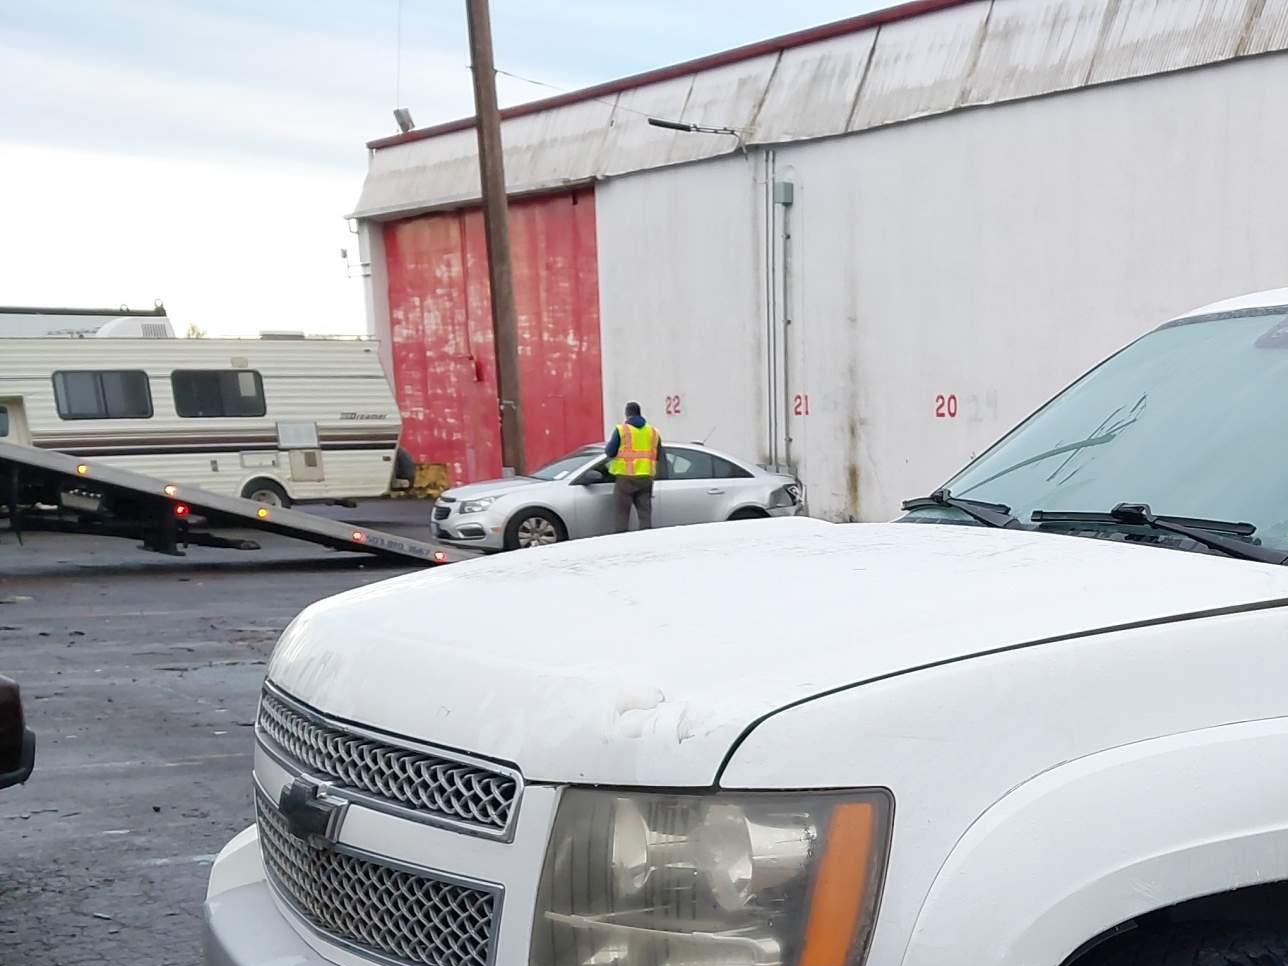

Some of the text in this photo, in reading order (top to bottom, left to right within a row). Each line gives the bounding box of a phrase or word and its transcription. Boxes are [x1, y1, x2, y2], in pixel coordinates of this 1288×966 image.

[665, 395, 681, 415] 22
[794, 395, 809, 415] 21
[935, 394, 958, 417] 20
